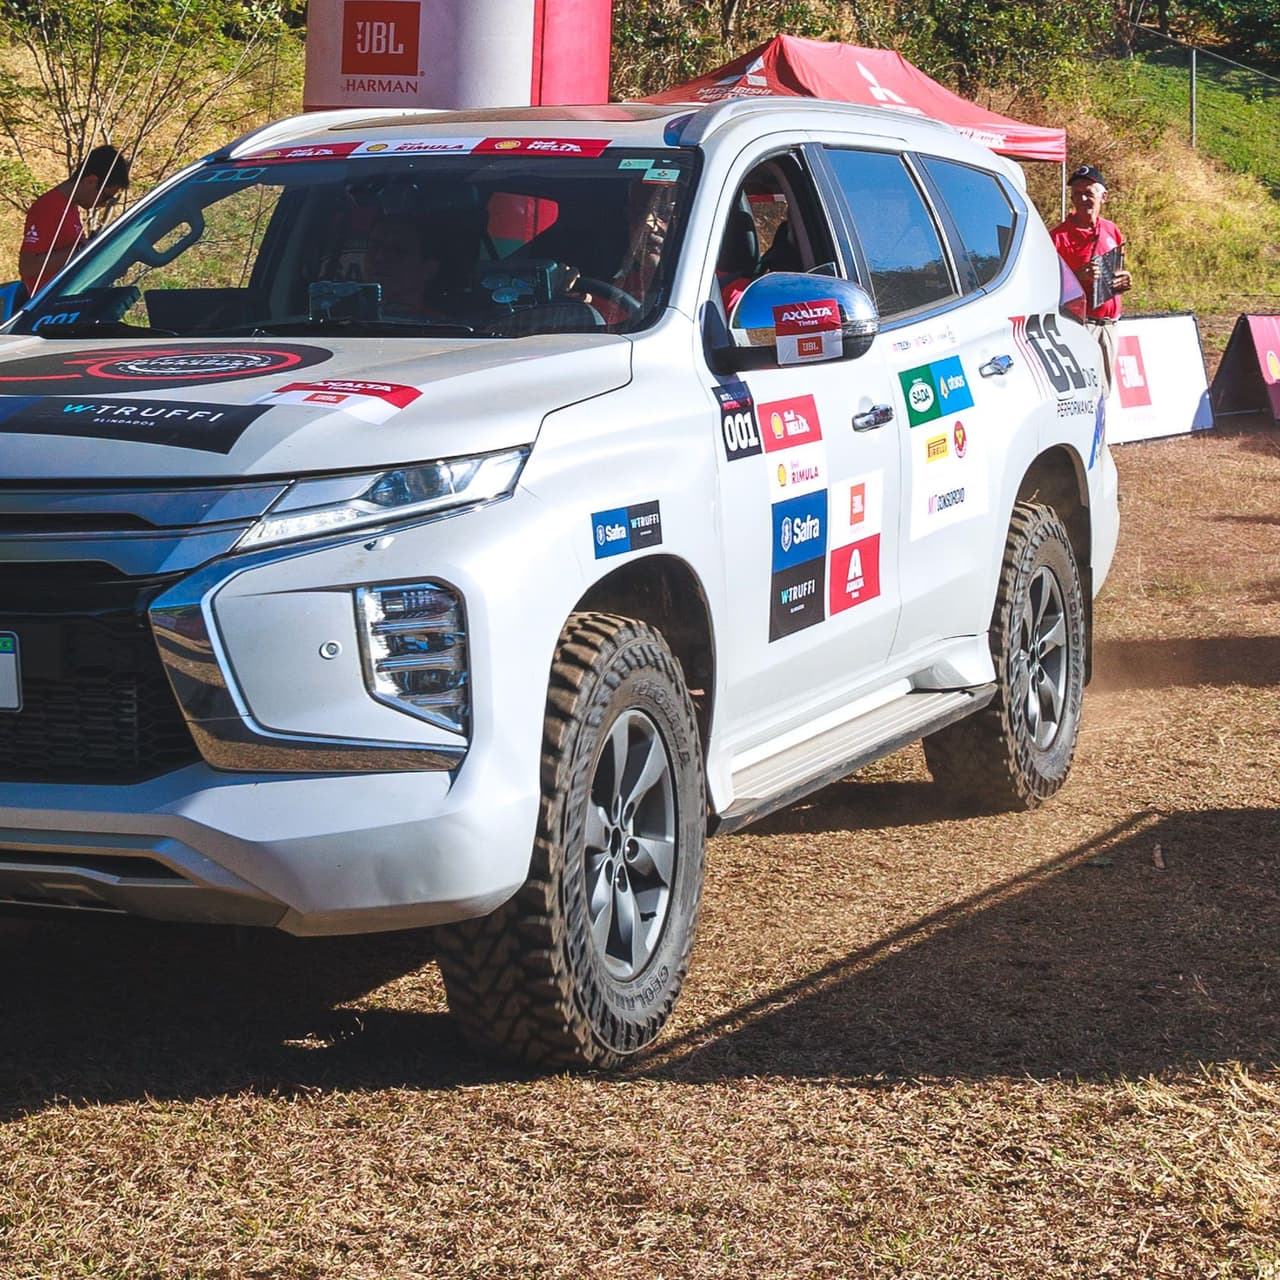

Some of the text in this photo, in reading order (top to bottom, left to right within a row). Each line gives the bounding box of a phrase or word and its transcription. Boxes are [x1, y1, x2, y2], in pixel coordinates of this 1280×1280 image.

[356, 22, 404, 54] JBL
[346, 79, 418, 93] HARMAN
[782, 307, 833, 322] AXALTA
[912, 388, 931, 404] SADA
[724, 412, 759, 451] 001
[791, 466, 819, 484] RIMULA
[605, 524, 627, 541] Safra
[793, 514, 820, 544] Safra
